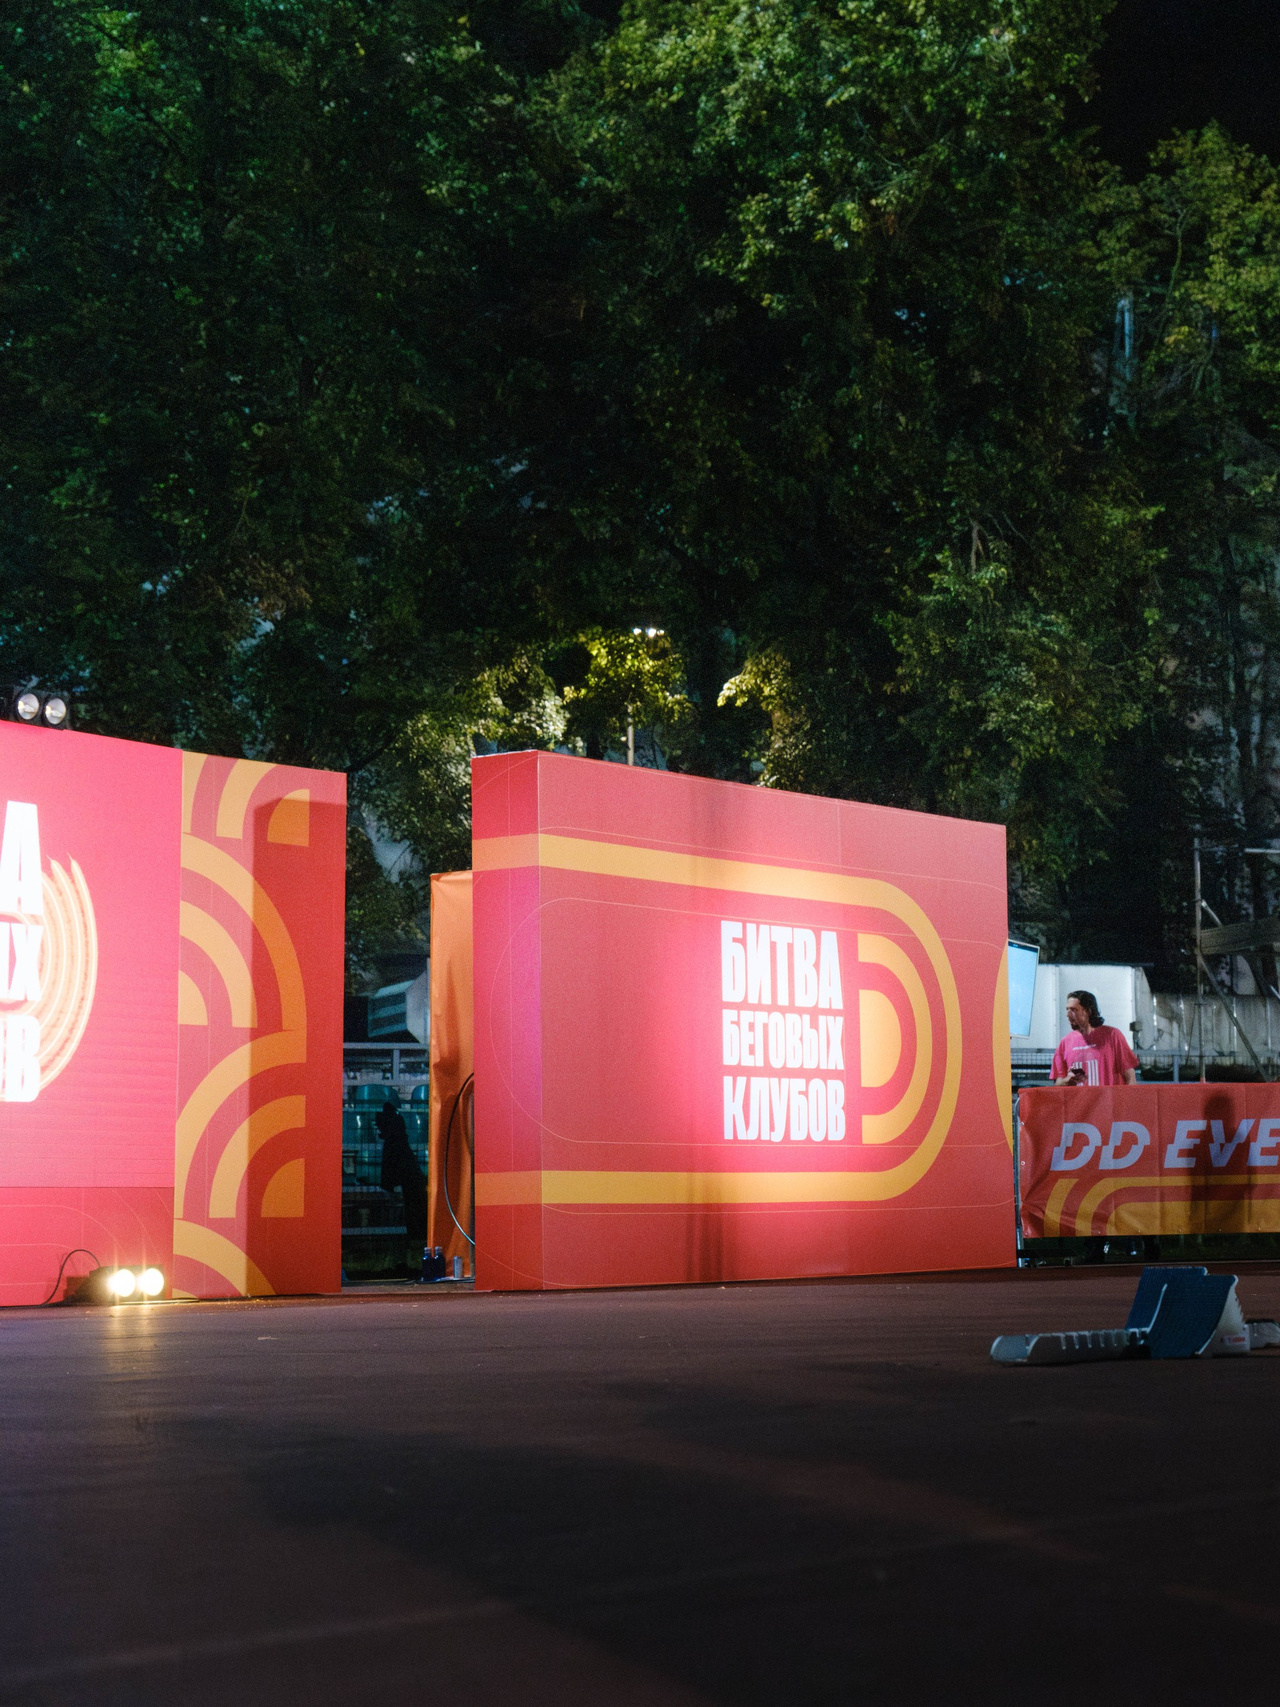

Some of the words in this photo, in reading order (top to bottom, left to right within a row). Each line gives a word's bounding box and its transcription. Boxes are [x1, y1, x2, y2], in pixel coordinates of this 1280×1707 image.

[721, 920, 844, 1009] БИТВА
[722, 1009, 845, 1070] БЕГОВЫХ
[723, 1076, 846, 1142] КЛУБОВ
[1050, 1121, 1151, 1171] DD
